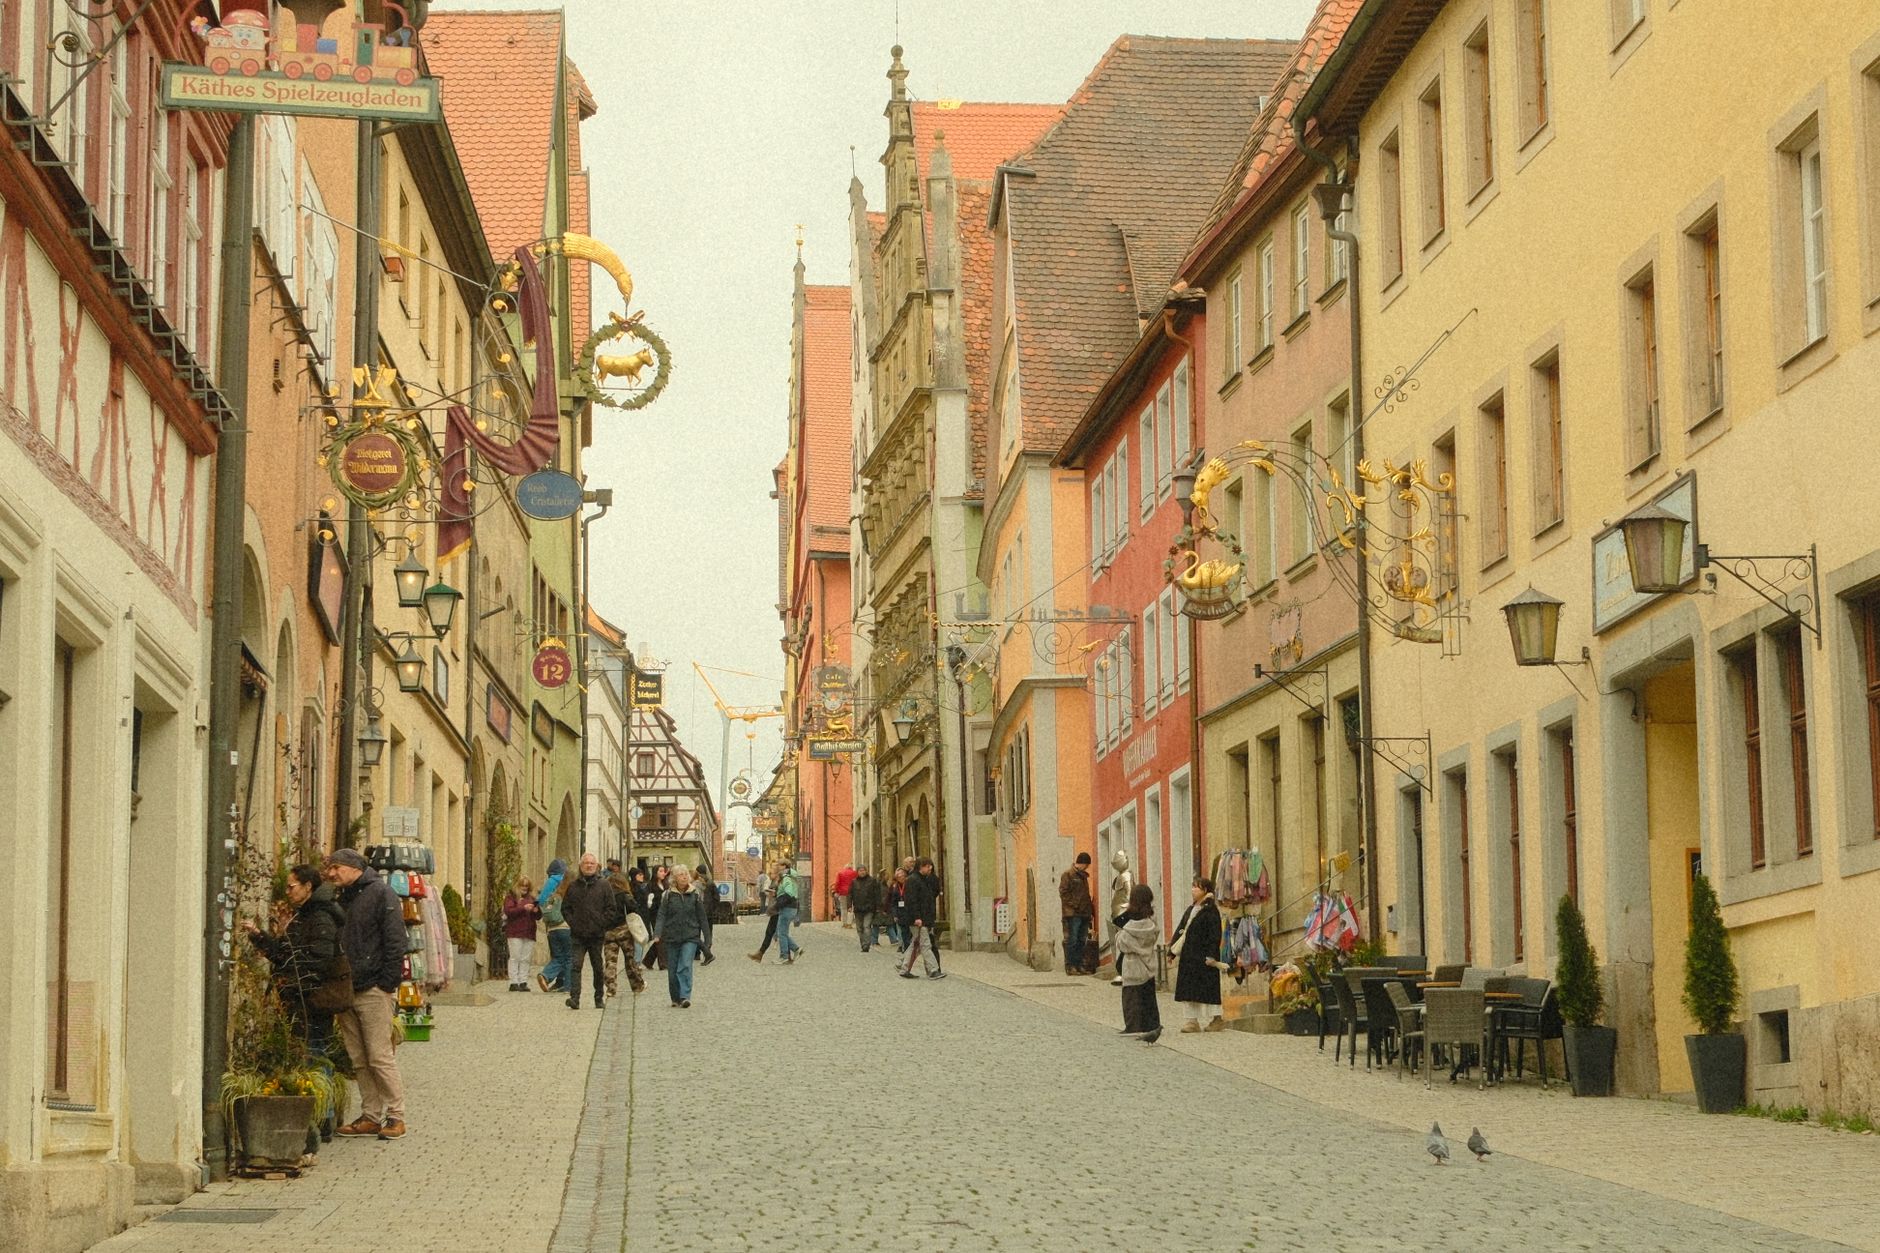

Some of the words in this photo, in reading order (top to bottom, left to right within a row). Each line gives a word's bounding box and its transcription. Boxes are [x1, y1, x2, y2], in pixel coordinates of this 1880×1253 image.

[181, 76, 256, 98] Käthes
[262, 81, 423, 108] Spielzeugladen
[540, 663, 564, 681] 12
